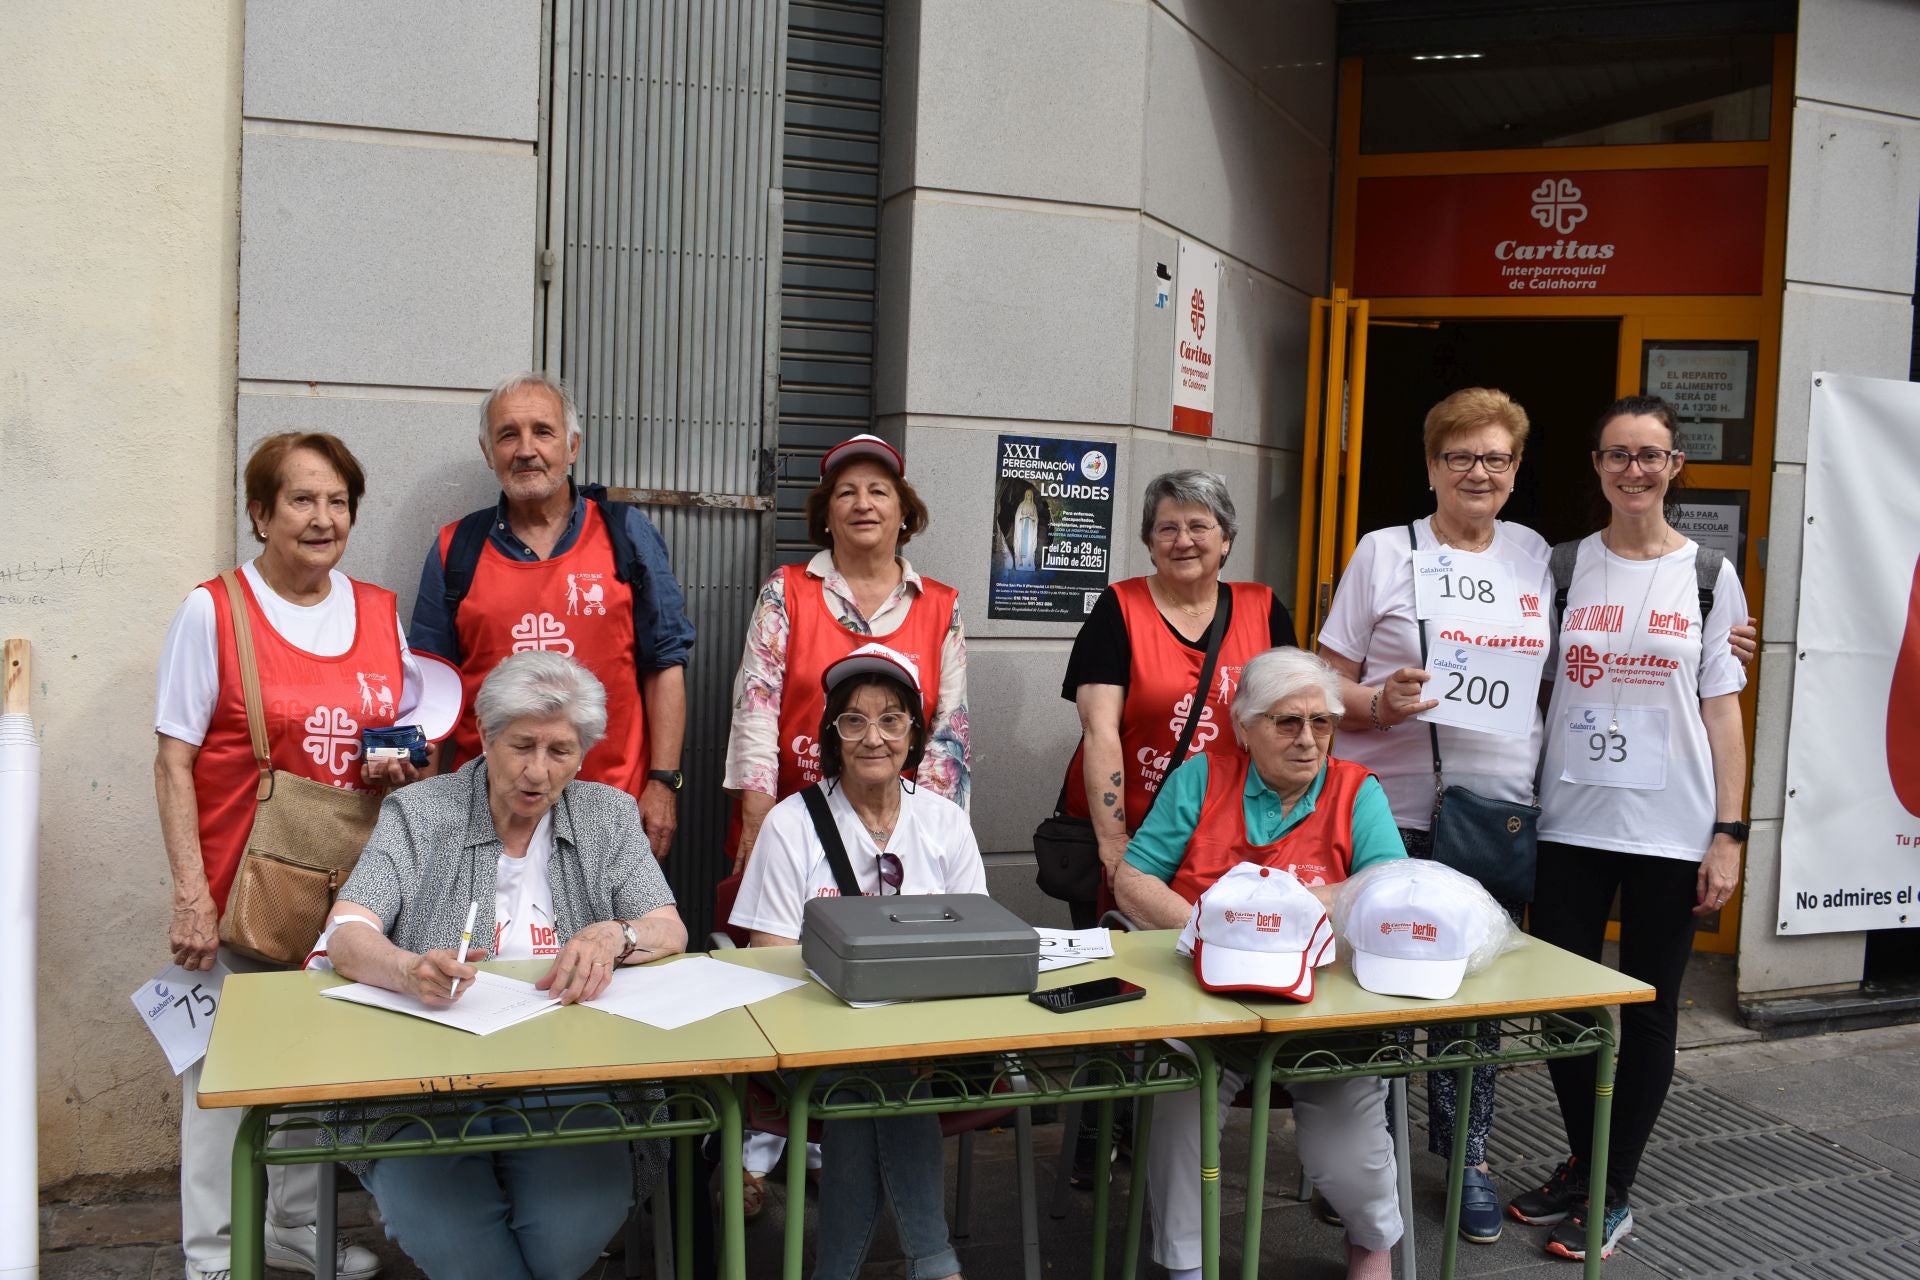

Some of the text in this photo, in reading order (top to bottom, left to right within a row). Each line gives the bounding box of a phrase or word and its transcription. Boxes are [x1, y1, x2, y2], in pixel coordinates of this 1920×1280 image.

[1502, 264, 1607, 278] Interparroquial
[1509, 278, 1597, 289] de Calahorra
[1180, 340, 1212, 366] Cáritas
[1181, 363, 1209, 380] Interparroquial
[1667, 371, 1728, 380] EL REPARTO
[1182, 377, 1207, 391] de Calahorra
[1660, 382, 1733, 391] DE ALIMENTOS
[1675, 391, 1701, 400] SERÁ
[1682, 403, 1689, 411] A
[1720, 404, 1731, 412] H.
[1003, 443, 1040, 459] XXXI
[1002, 458, 1075, 472] PEREGRINACIÓN
[1002, 469, 1063, 481] DIOCESANA A
[1040, 482, 1110, 500] LOURDES
[1697, 511, 1719, 519] PARA
[1693, 522, 1729, 531] ESCOLAR
[1049, 541, 1102, 554] del 26 al 29 de
[1046, 553, 1102, 567] Junio de 2025
[1420, 566, 1453, 574] Calahorra
[1438, 574, 1495, 604] 108
[1519, 593, 1540, 611] rlin
[1566, 605, 1625, 633] SOLIDARIA
[1648, 609, 1690, 633] berlin
[1475, 634, 1545, 648] Cáritas
[1433, 658, 1467, 671] Calahorra
[1602, 652, 1680, 670] Cáritas
[1608, 667, 1672, 678] Interparroquial
[1624, 677, 1665, 687] Calahorra
[1444, 671, 1510, 709] 200
[1569, 722, 1596, 731] Calahorra
[1589, 732, 1628, 763] 93
[803, 771, 817, 782] de
[1895, 834, 1911, 846] Tu
[1796, 891, 1818, 910] No
[1822, 887, 1892, 908] admires
[1896, 885, 1912, 904] el
[1256, 912, 1281, 928] berlin
[1412, 921, 1437, 938] berlin
[148, 994, 175, 1018] Calahorra
[173, 983, 217, 1029] 75
